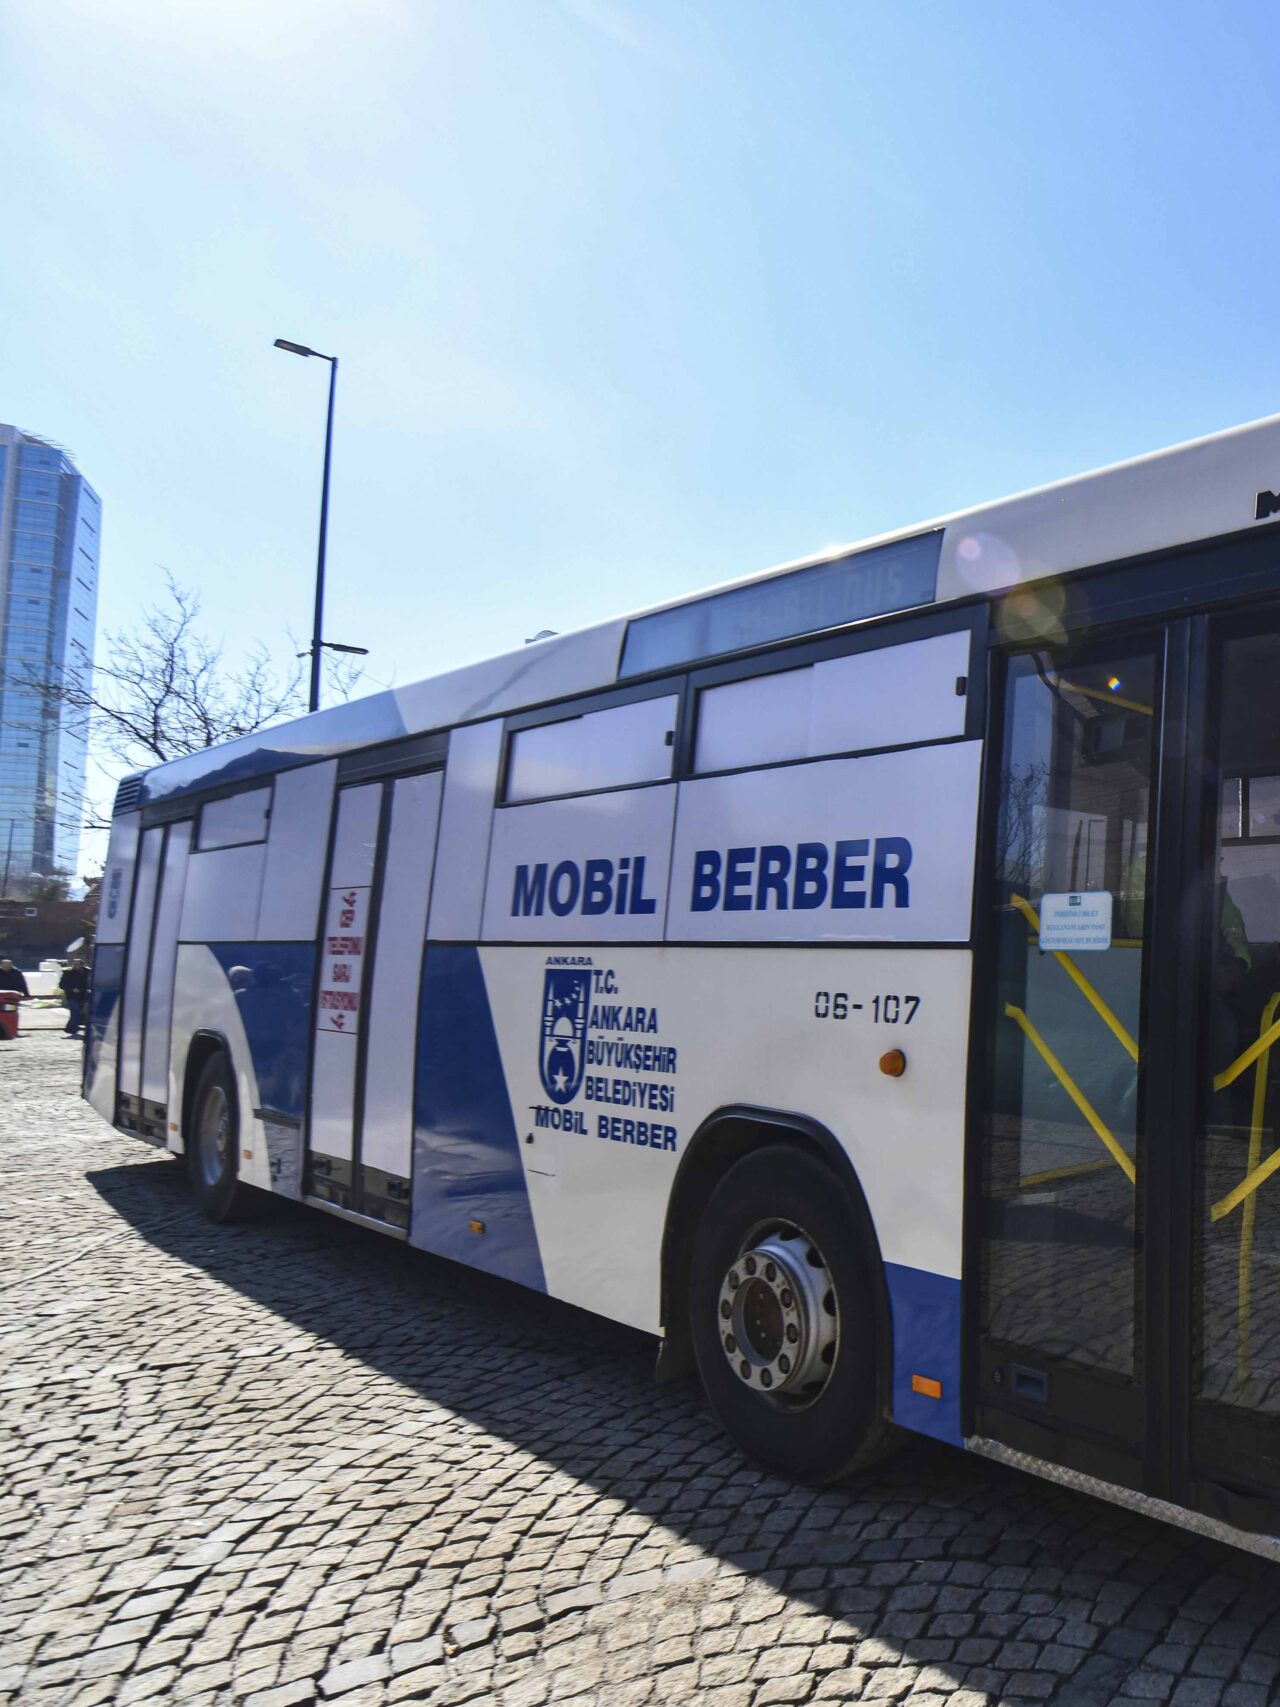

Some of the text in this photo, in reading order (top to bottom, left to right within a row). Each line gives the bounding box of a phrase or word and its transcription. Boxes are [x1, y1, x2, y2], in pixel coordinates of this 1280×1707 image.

[690, 836, 913, 912] BERBER
[545, 956, 593, 966] ANKARA
[592, 969, 619, 994] T.C.
[588, 1005, 659, 1034] ANKARA
[814, 991, 920, 1025] 06-107
[597, 1114, 677, 1152] BERBER
